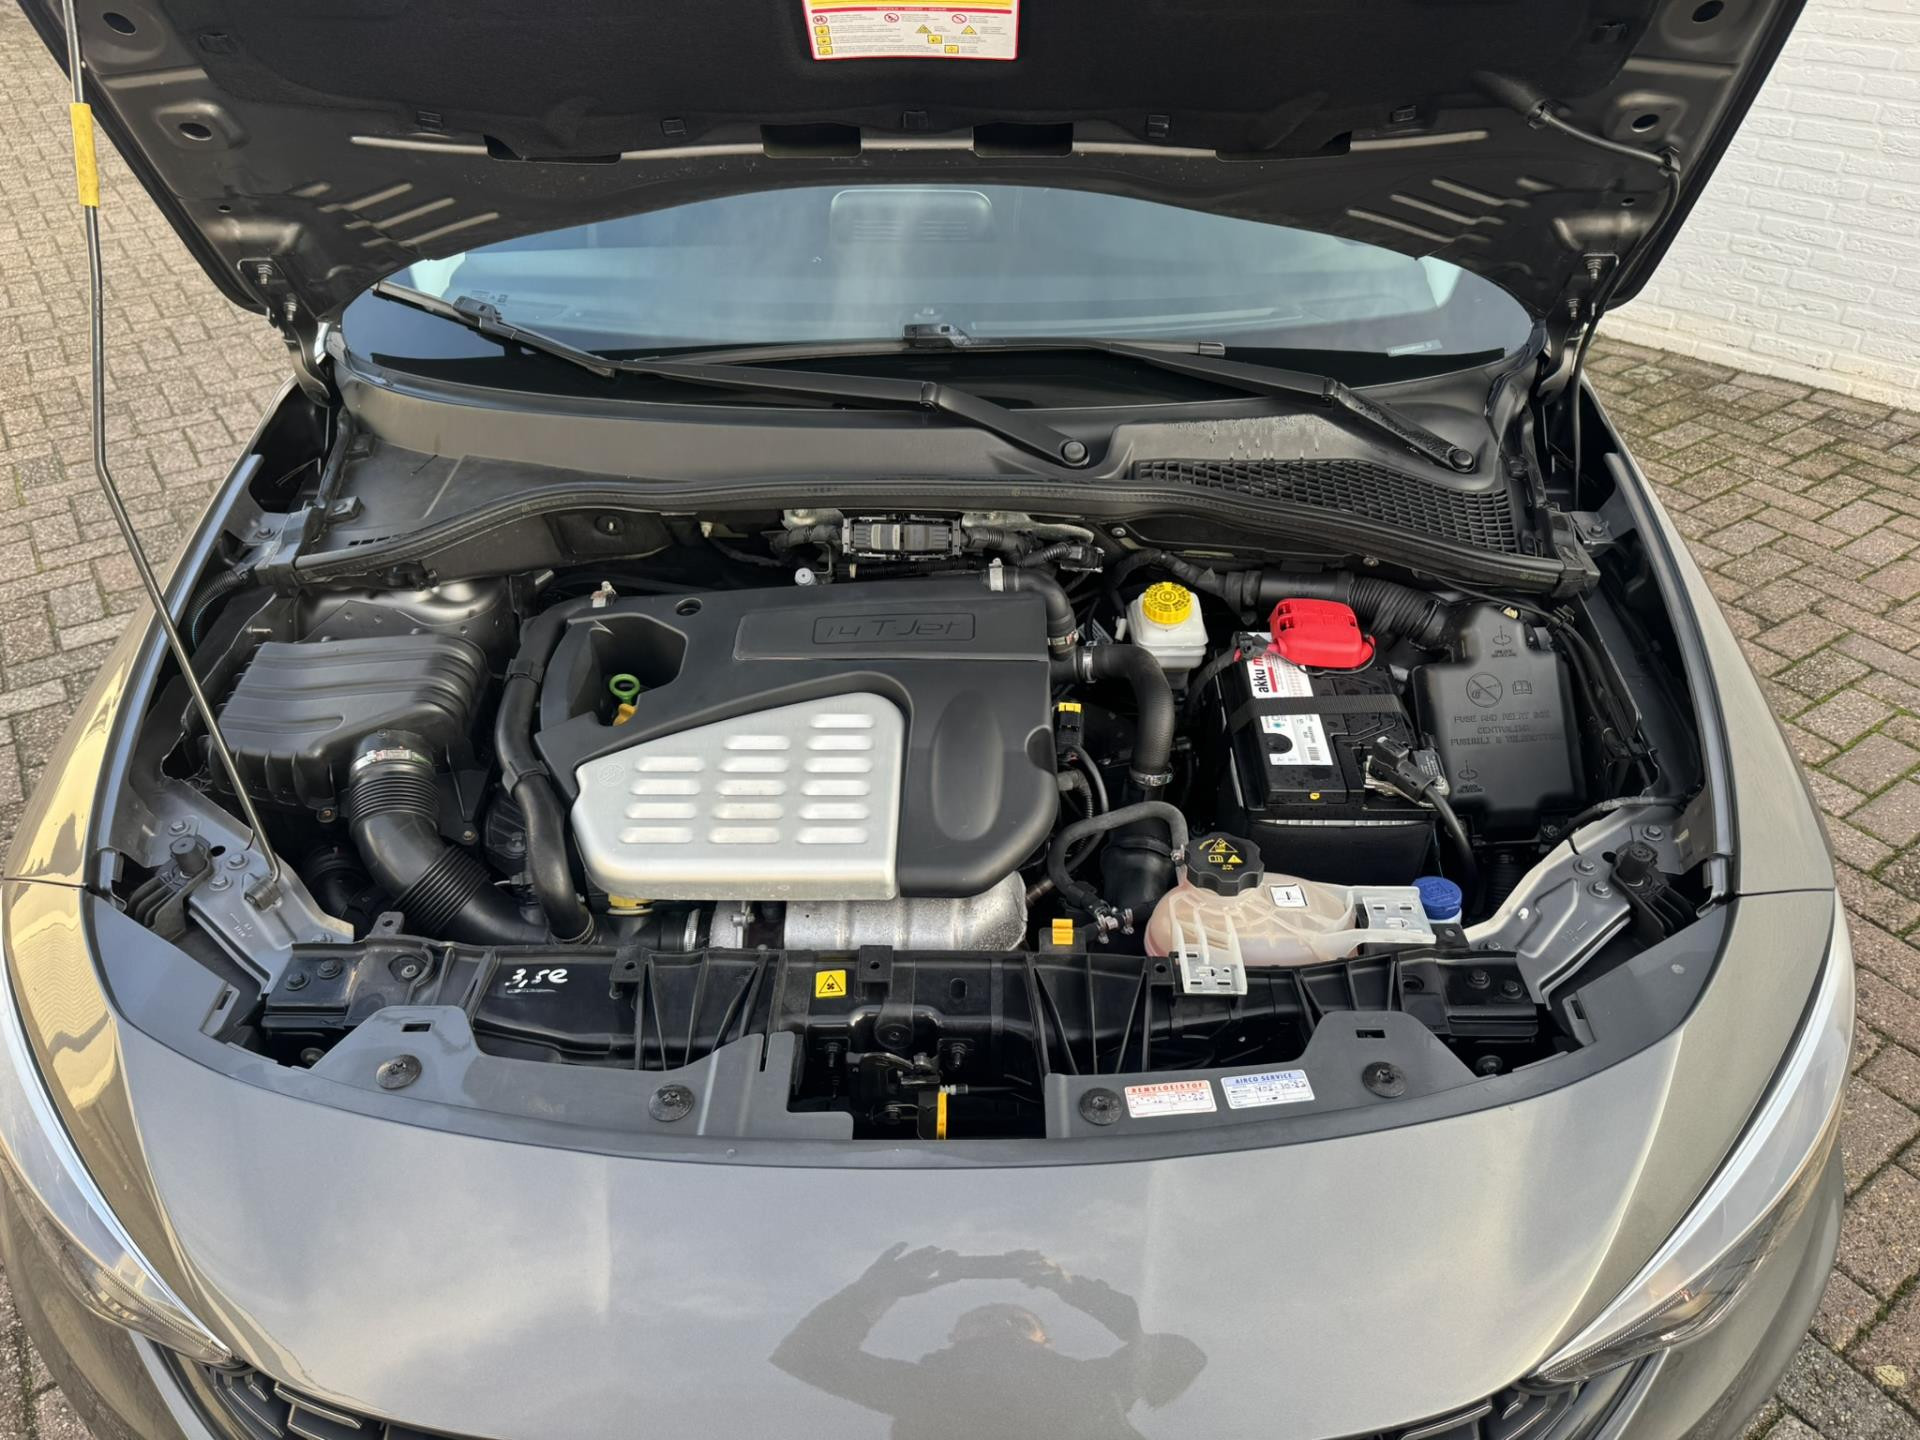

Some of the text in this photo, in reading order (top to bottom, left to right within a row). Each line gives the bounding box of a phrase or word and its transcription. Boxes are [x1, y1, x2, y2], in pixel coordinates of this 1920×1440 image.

[1252, 669, 1270, 693] akku
[1454, 715, 1477, 723] FUSE
[1480, 713, 1498, 722] AND
[1235, 1072, 1293, 1085] AIRCO SERVICE
[1131, 1082, 1203, 1094] REMVLOEISTOF
